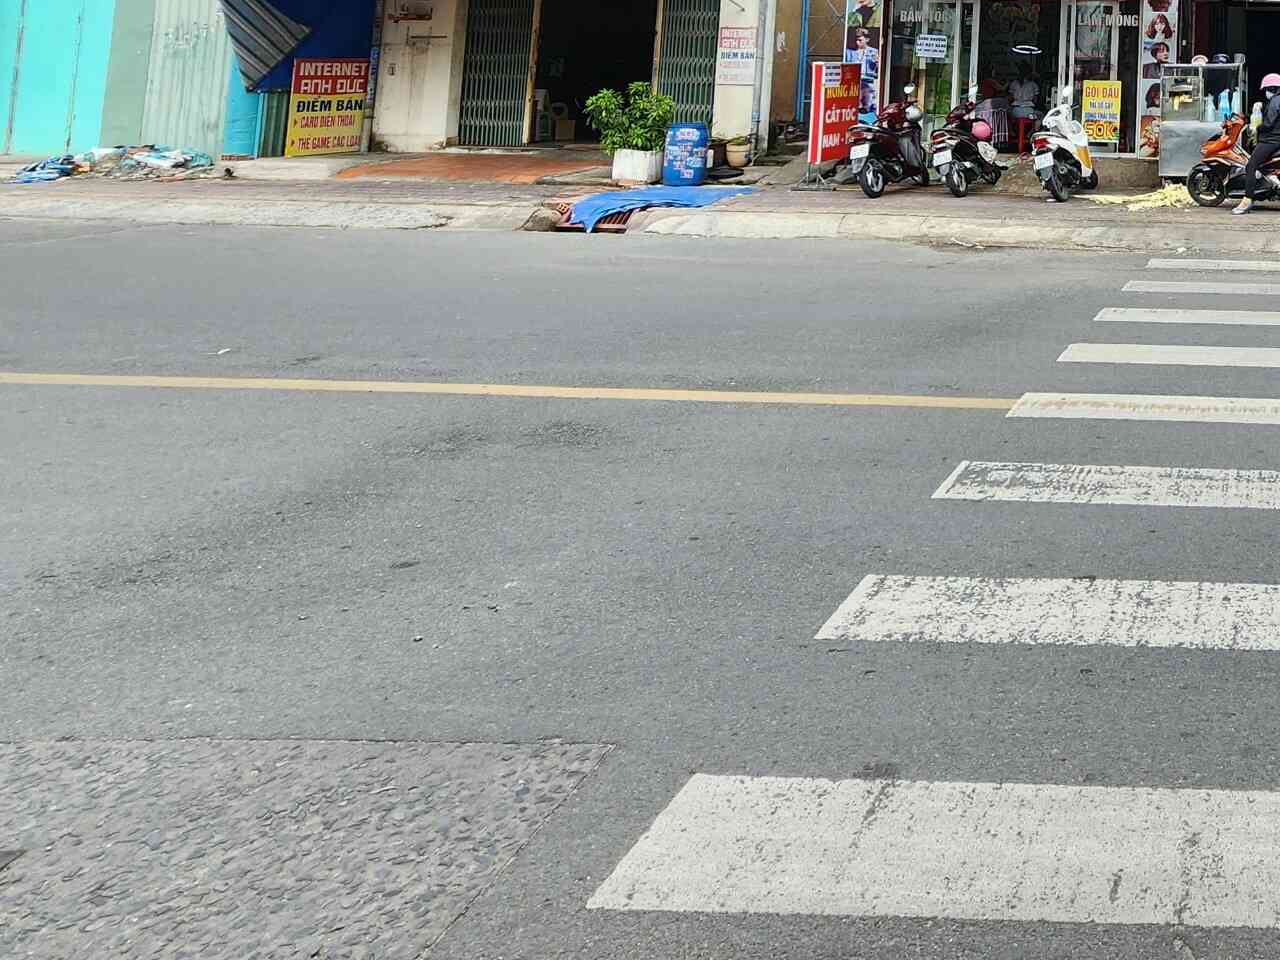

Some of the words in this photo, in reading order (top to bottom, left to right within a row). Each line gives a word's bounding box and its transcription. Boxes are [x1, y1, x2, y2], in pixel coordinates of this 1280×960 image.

[299, 62, 369, 76] INTERNET
[300, 79, 332, 93] ANH
[823, 132, 840, 148] NAM
